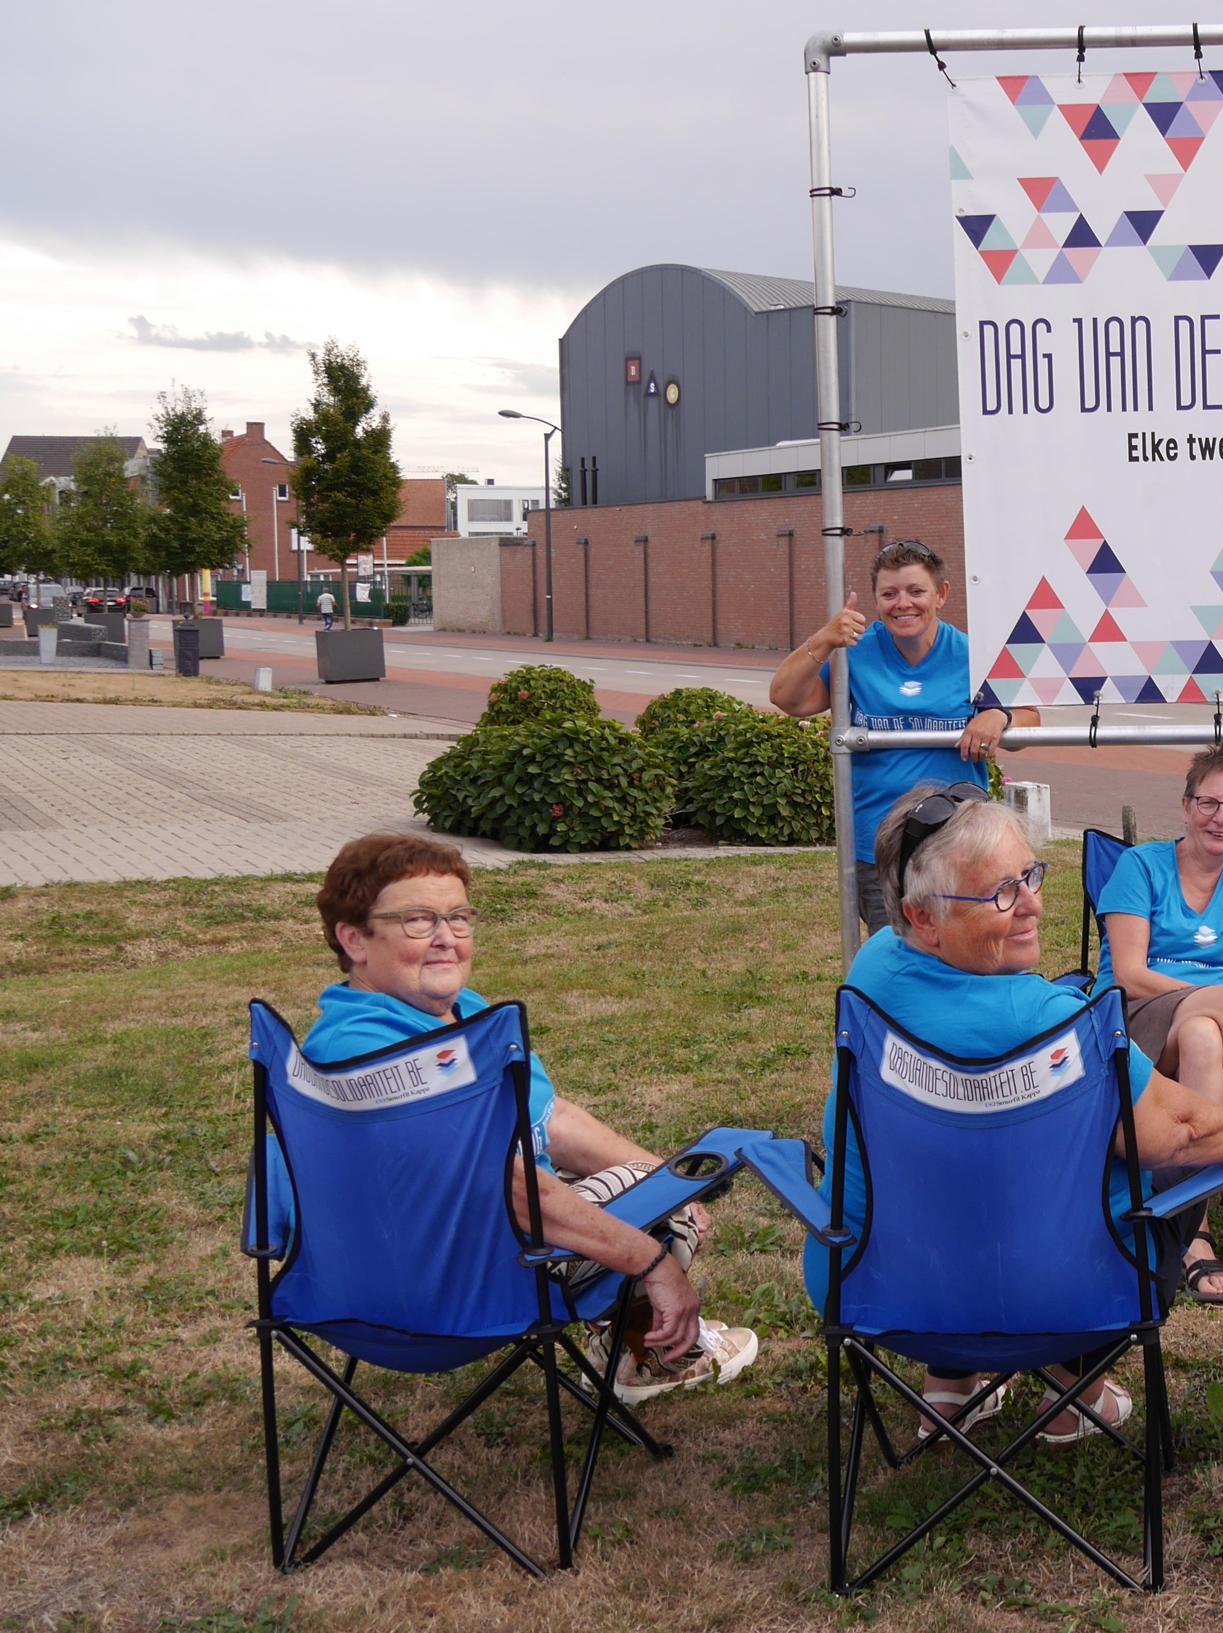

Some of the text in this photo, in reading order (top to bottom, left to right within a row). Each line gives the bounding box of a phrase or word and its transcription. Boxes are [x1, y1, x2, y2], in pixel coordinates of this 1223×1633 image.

[979, 318, 1054, 415] DAG
[1073, 316, 1154, 413] VAN
[1174, 314, 1223, 411] DE
[1127, 432, 1178, 463] Elke
[889, 1042, 1040, 1102] DAGVANDESOLIDARITEIT.BE
